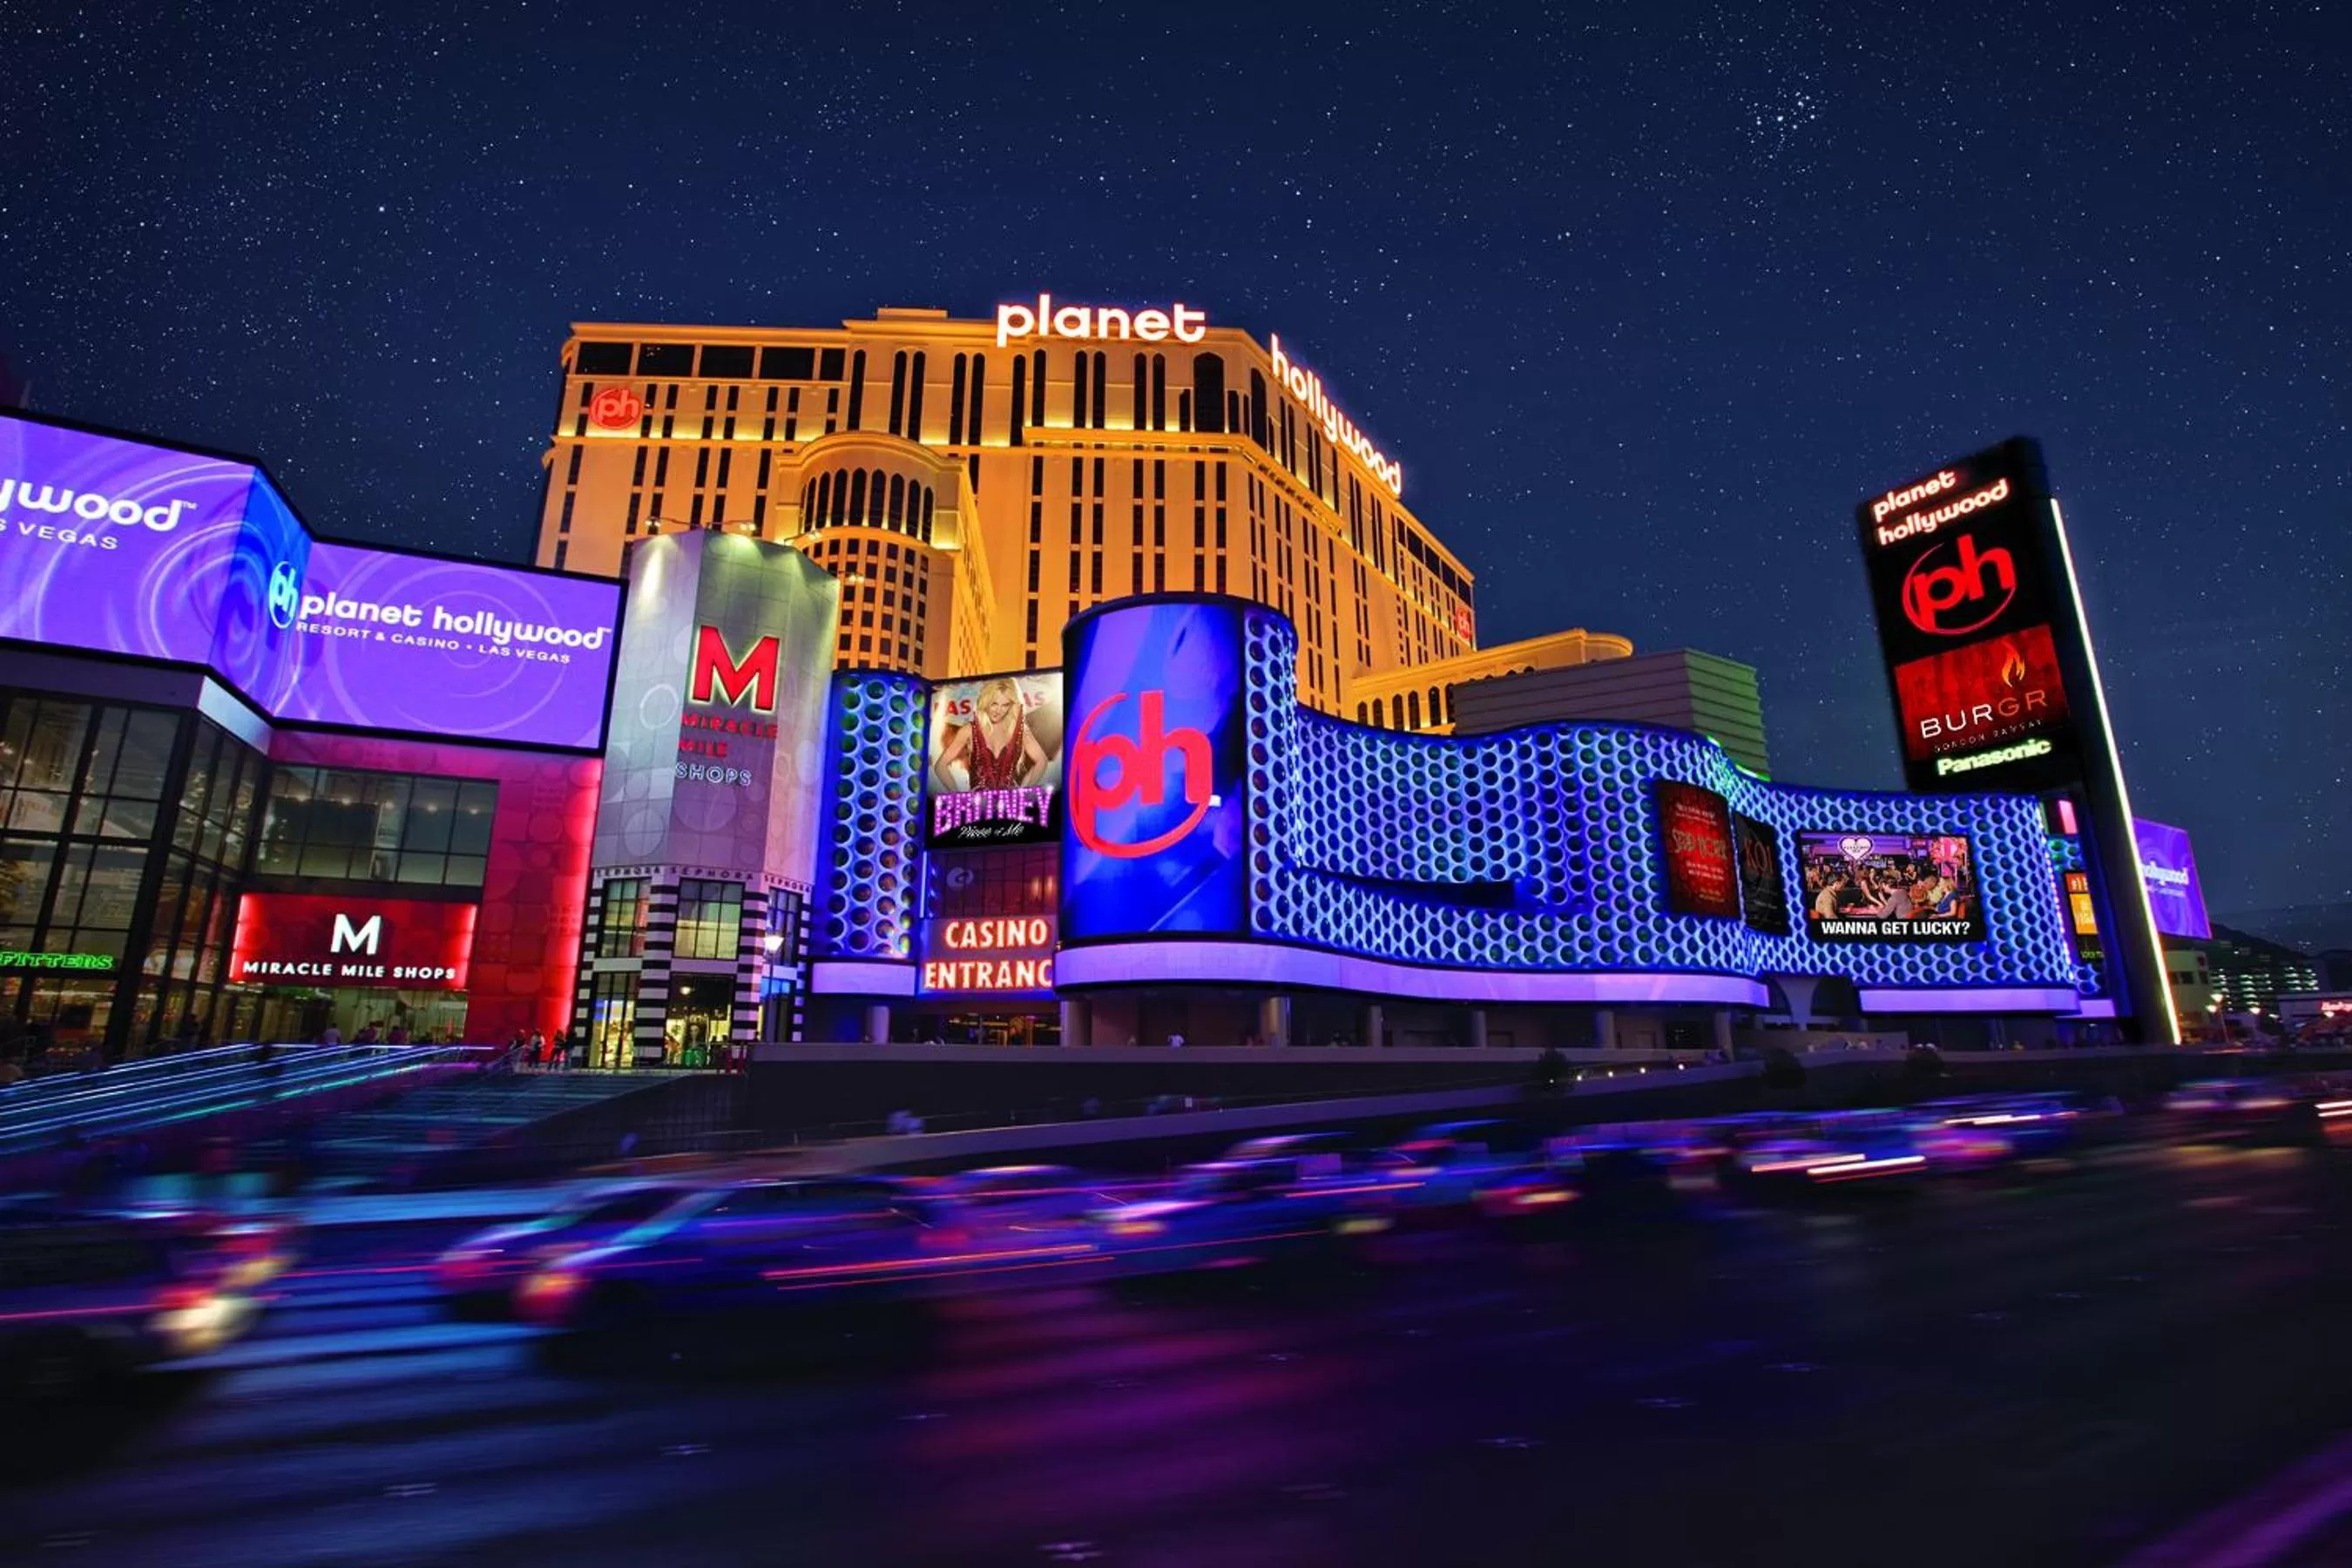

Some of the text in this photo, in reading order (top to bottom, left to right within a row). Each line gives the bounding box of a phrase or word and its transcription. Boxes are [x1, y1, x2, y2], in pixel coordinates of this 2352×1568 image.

[997, 294, 1206, 347] planet
[1271, 333, 1402, 496] hollywood
[1873, 470, 1957, 523] planet
[1877, 477, 2009, 545] hollywood
[17, 521, 118, 550] VEGAS
[1906, 533, 2018, 635] ph
[299, 591, 423, 627] planet
[295, 621, 571, 664] RESORT & CASINO LAS VEGAS
[689, 624, 781, 715] M
[680, 712, 779, 740] MIRACLE
[936, 700, 972, 715] AS
[1920, 689, 2047, 739] BURGR
[678, 738, 729, 760] MILE
[1937, 739, 2052, 776] Panasonic
[674, 761, 754, 787] SHOPS
[1073, 690, 1213, 852] ph
[934, 784, 1055, 837] BRITNEY
[670, 867, 754, 881] SEPHORA
[764, 875, 810, 893] SEPHORA
[330, 913, 382, 956] M
[944, 918, 1048, 949] CASINO
[1821, 921, 1970, 936] WANNA GET LUCKY?
[242, 962, 456, 979] MIRACLE MILE SHOPS
